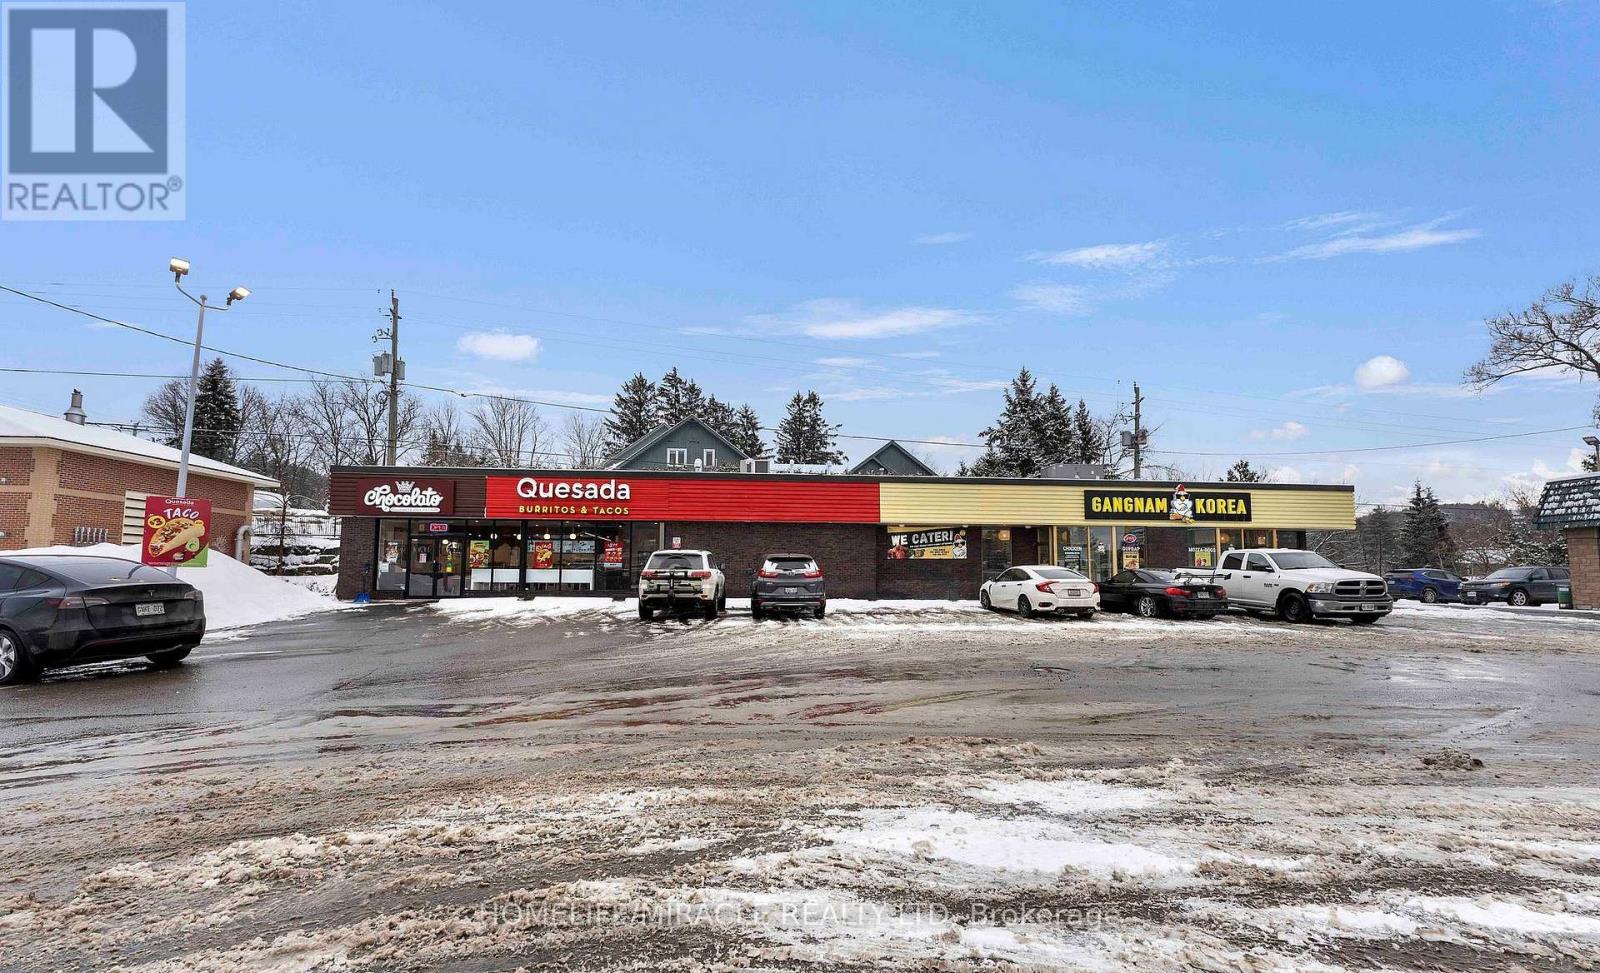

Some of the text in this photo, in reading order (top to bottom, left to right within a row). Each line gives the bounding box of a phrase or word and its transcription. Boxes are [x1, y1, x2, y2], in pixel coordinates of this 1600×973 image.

[517, 477, 631, 500] Quesada
[364, 484, 444, 512] Chocolato
[1091, 496, 1247, 515] GANGNAM KOREA
[163, 507, 200, 519] TACO
[519, 505, 629, 515] BURRITOS & TACOS
[891, 534, 908, 546] WE
